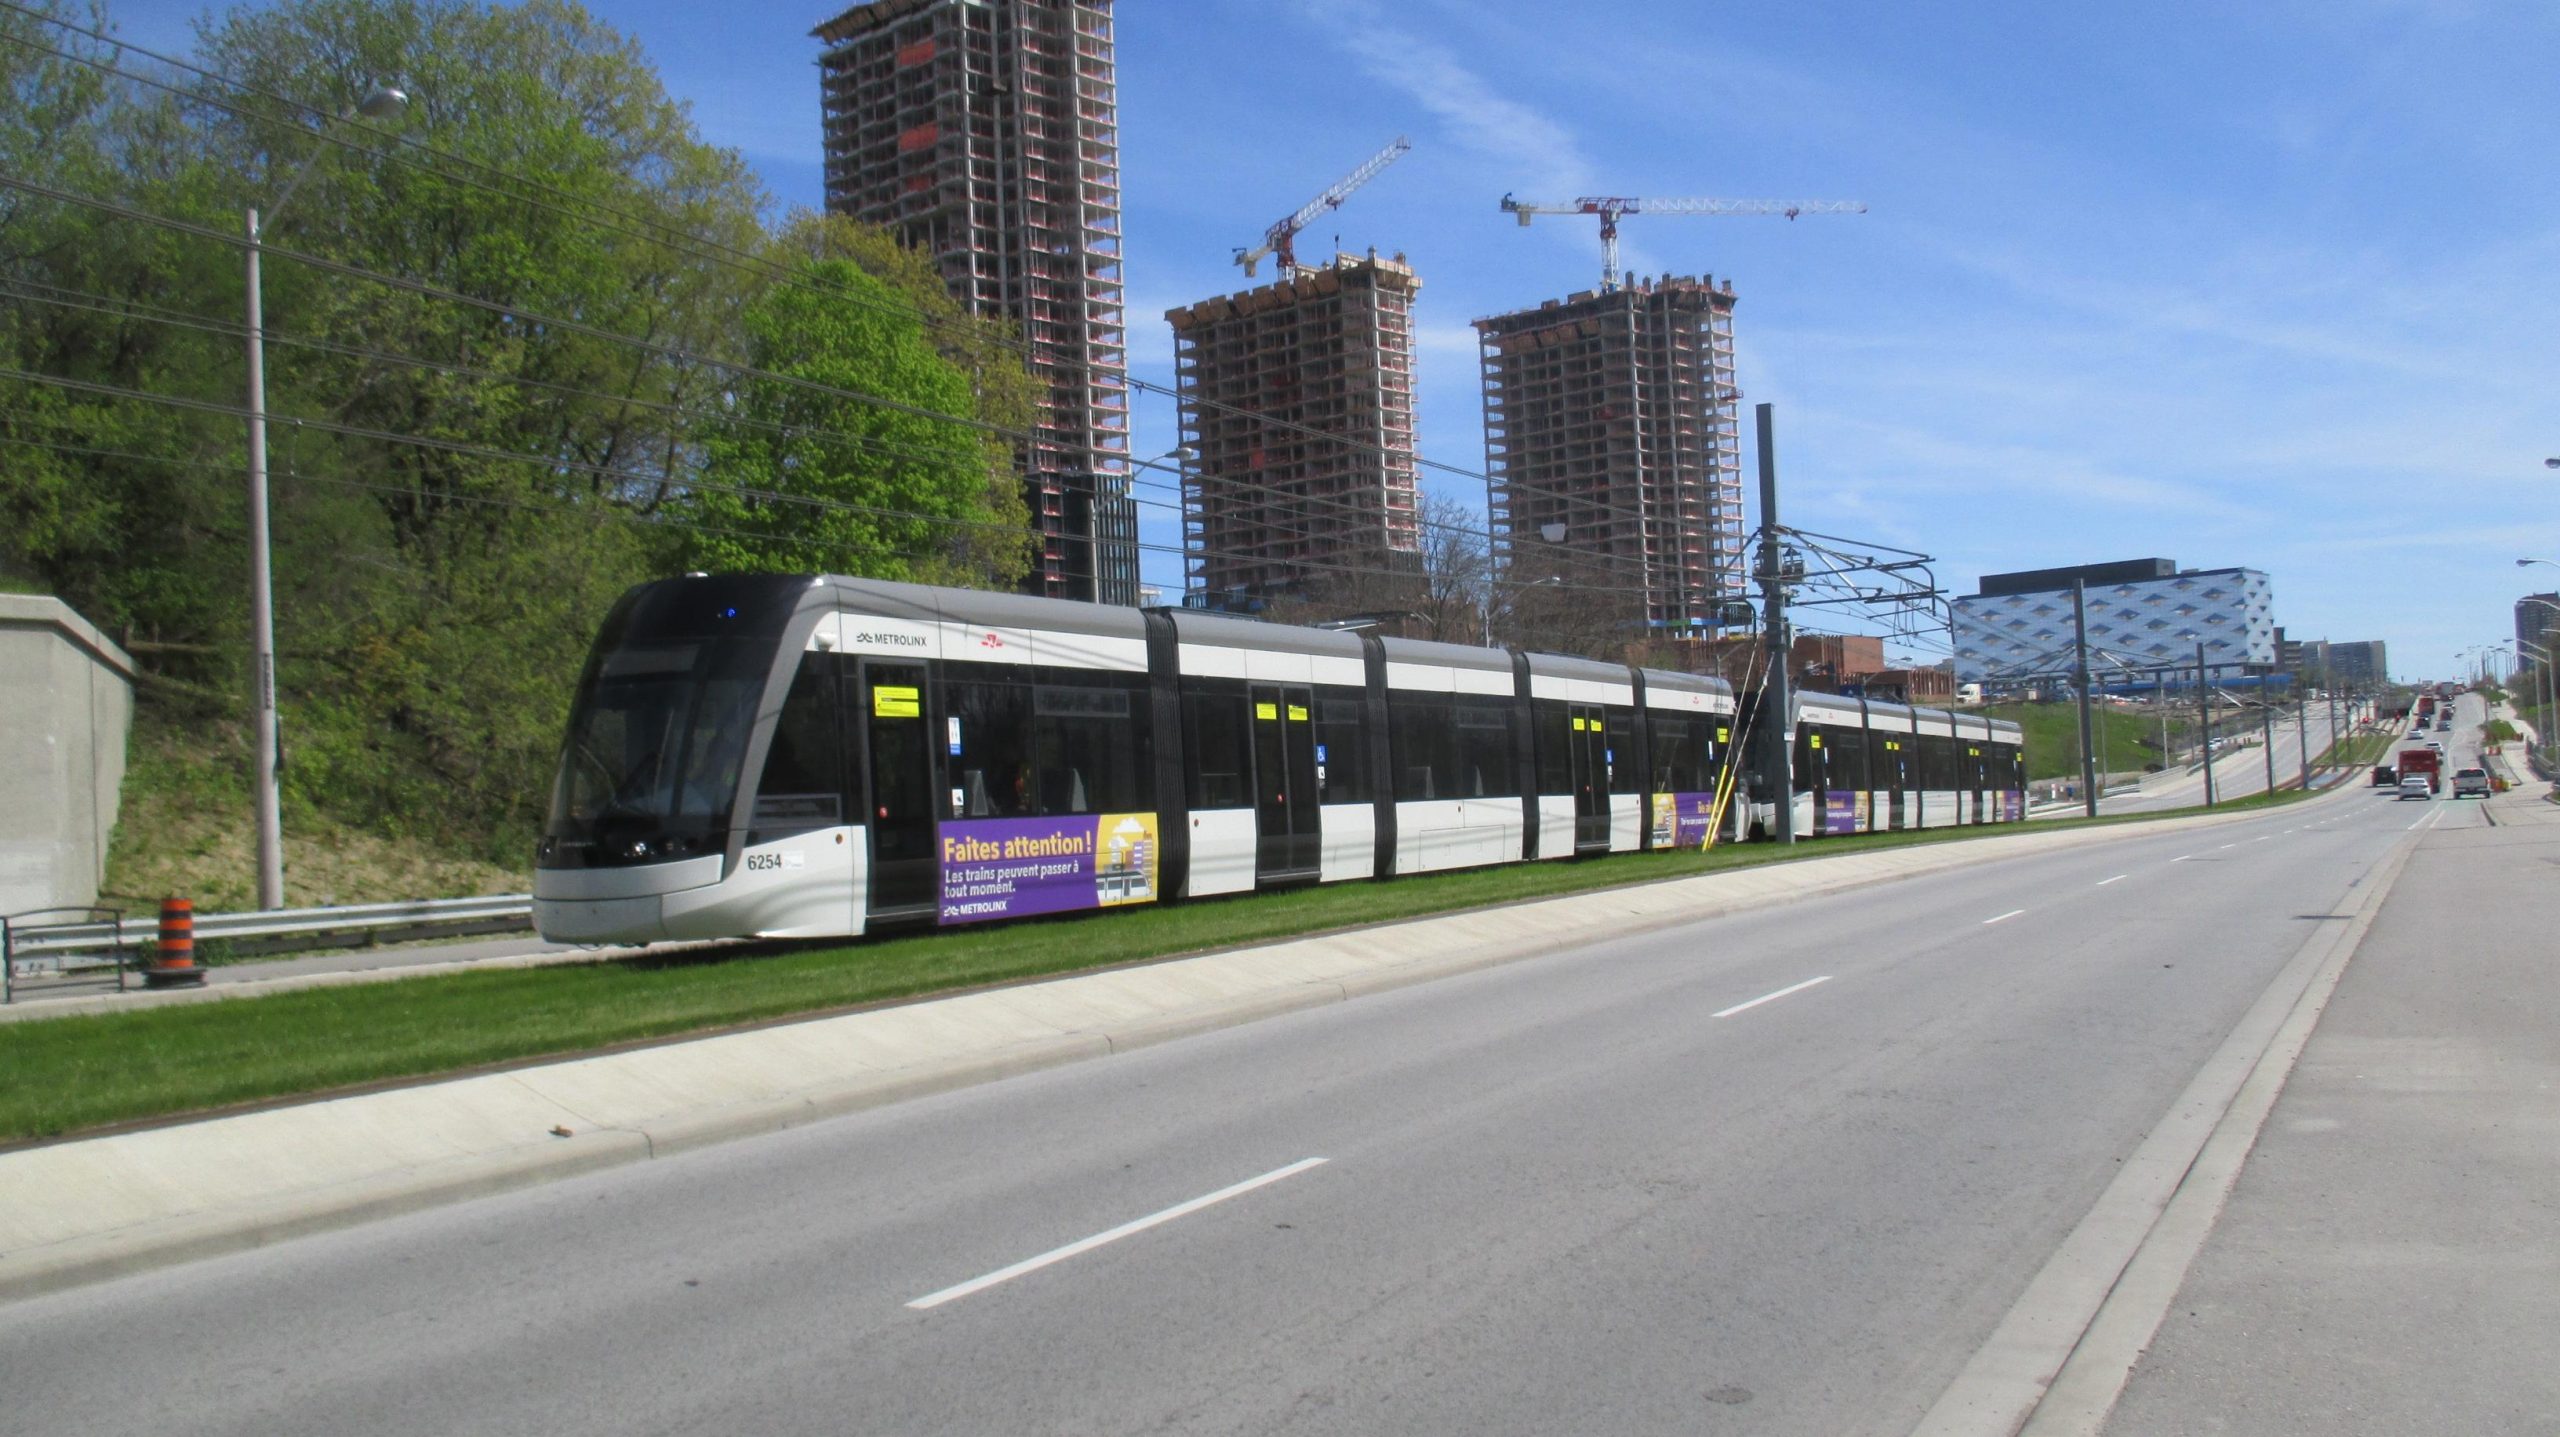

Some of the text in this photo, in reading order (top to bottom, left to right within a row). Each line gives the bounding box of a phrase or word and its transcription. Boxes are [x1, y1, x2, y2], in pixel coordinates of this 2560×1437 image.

[874, 633, 928, 647] METROLINX
[943, 836, 1000, 863] Faites
[1004, 831, 1083, 859] attention
[747, 853, 782, 871] 6254
[945, 860, 1079, 884] Les trains peuvent passer à
[944, 880, 1016, 898] tout moment.
[959, 900, 1007, 915] METROLINX
